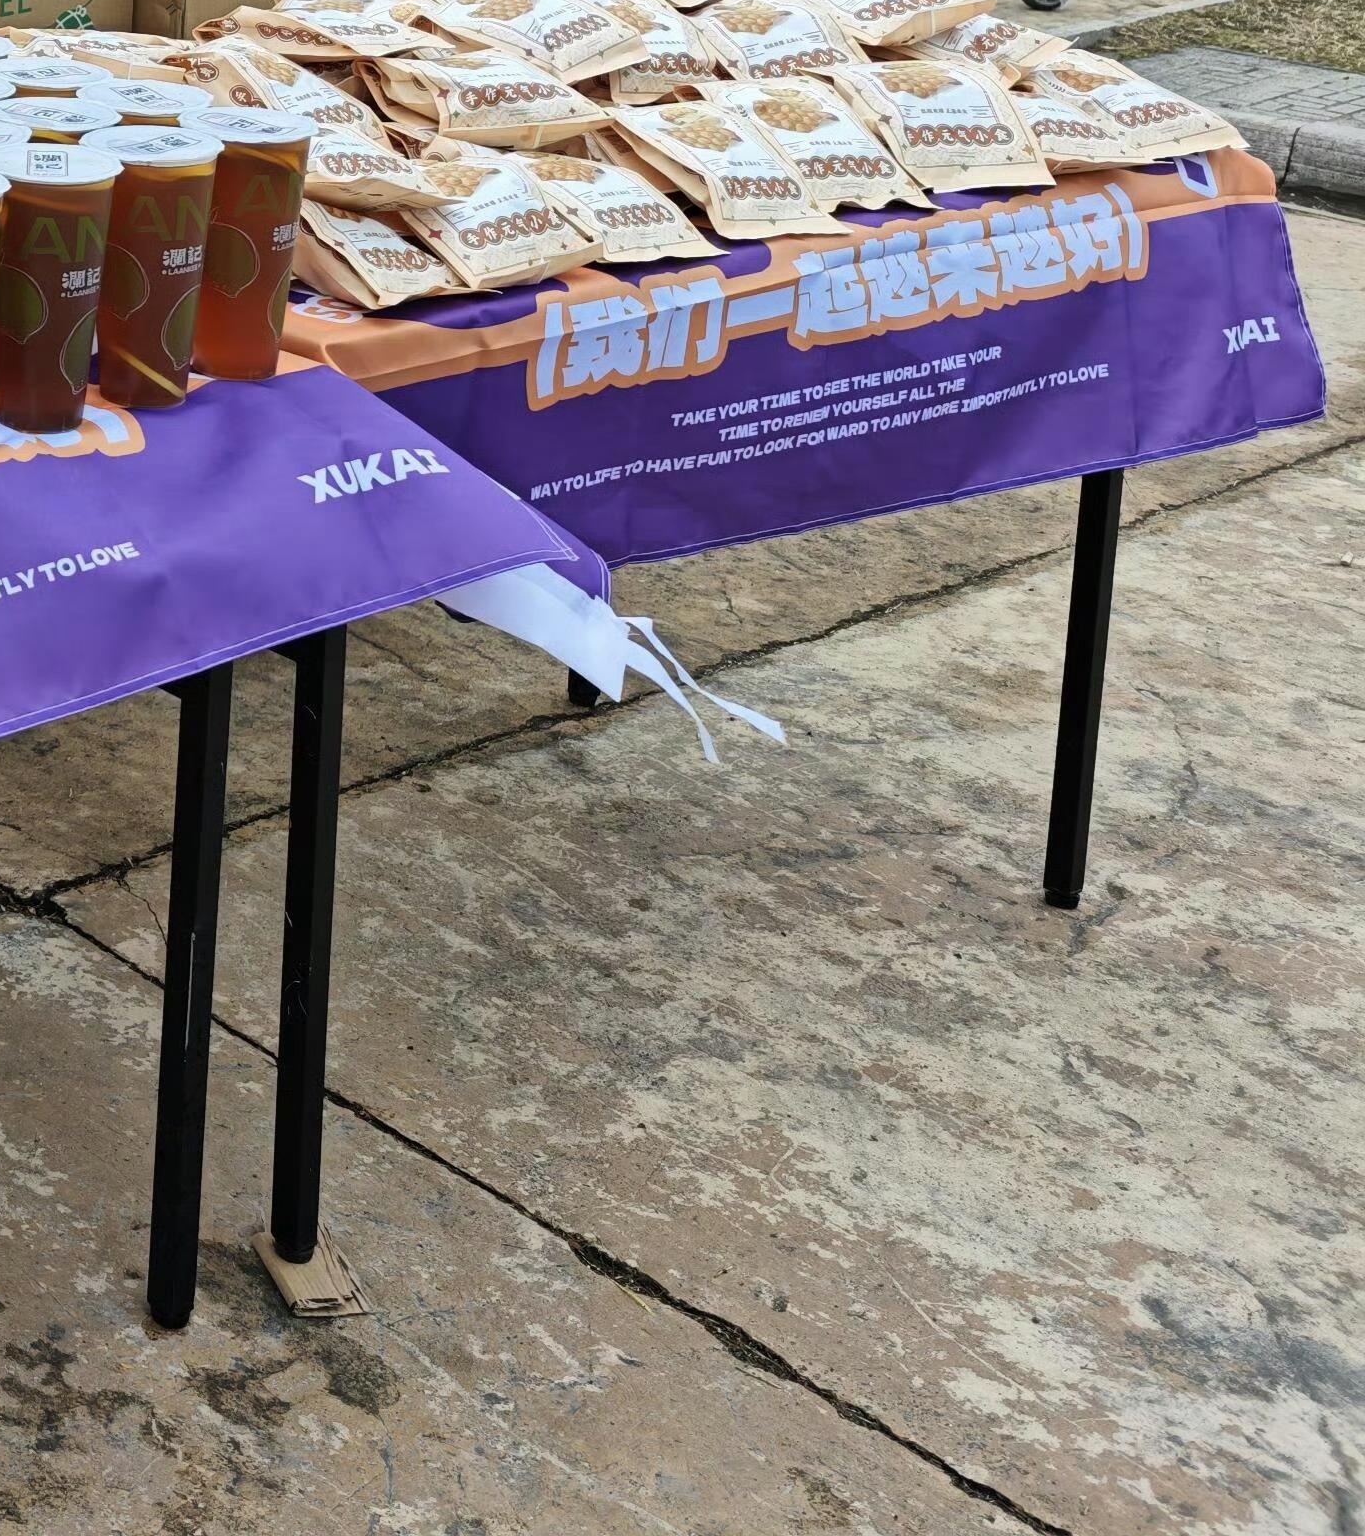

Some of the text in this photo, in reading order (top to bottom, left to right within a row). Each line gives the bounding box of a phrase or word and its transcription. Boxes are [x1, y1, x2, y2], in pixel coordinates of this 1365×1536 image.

[670, 345, 1003, 427] TAKE YOUR TIME TO SEE THE WORLD TAKE YOUR
[719, 377, 967, 443] TIME TO RENEW YOURSELF ALL THE
[530, 362, 1111, 501] WAY TO LIFE TO HAVE FUN TO LOOK FOR WARD TO ANY MORE IMPORTANTLY TO LOVE
[296, 445, 452, 505] XUKAI
[38, 555, 77, 584] TO
[75, 541, 141, 574] LOVE
